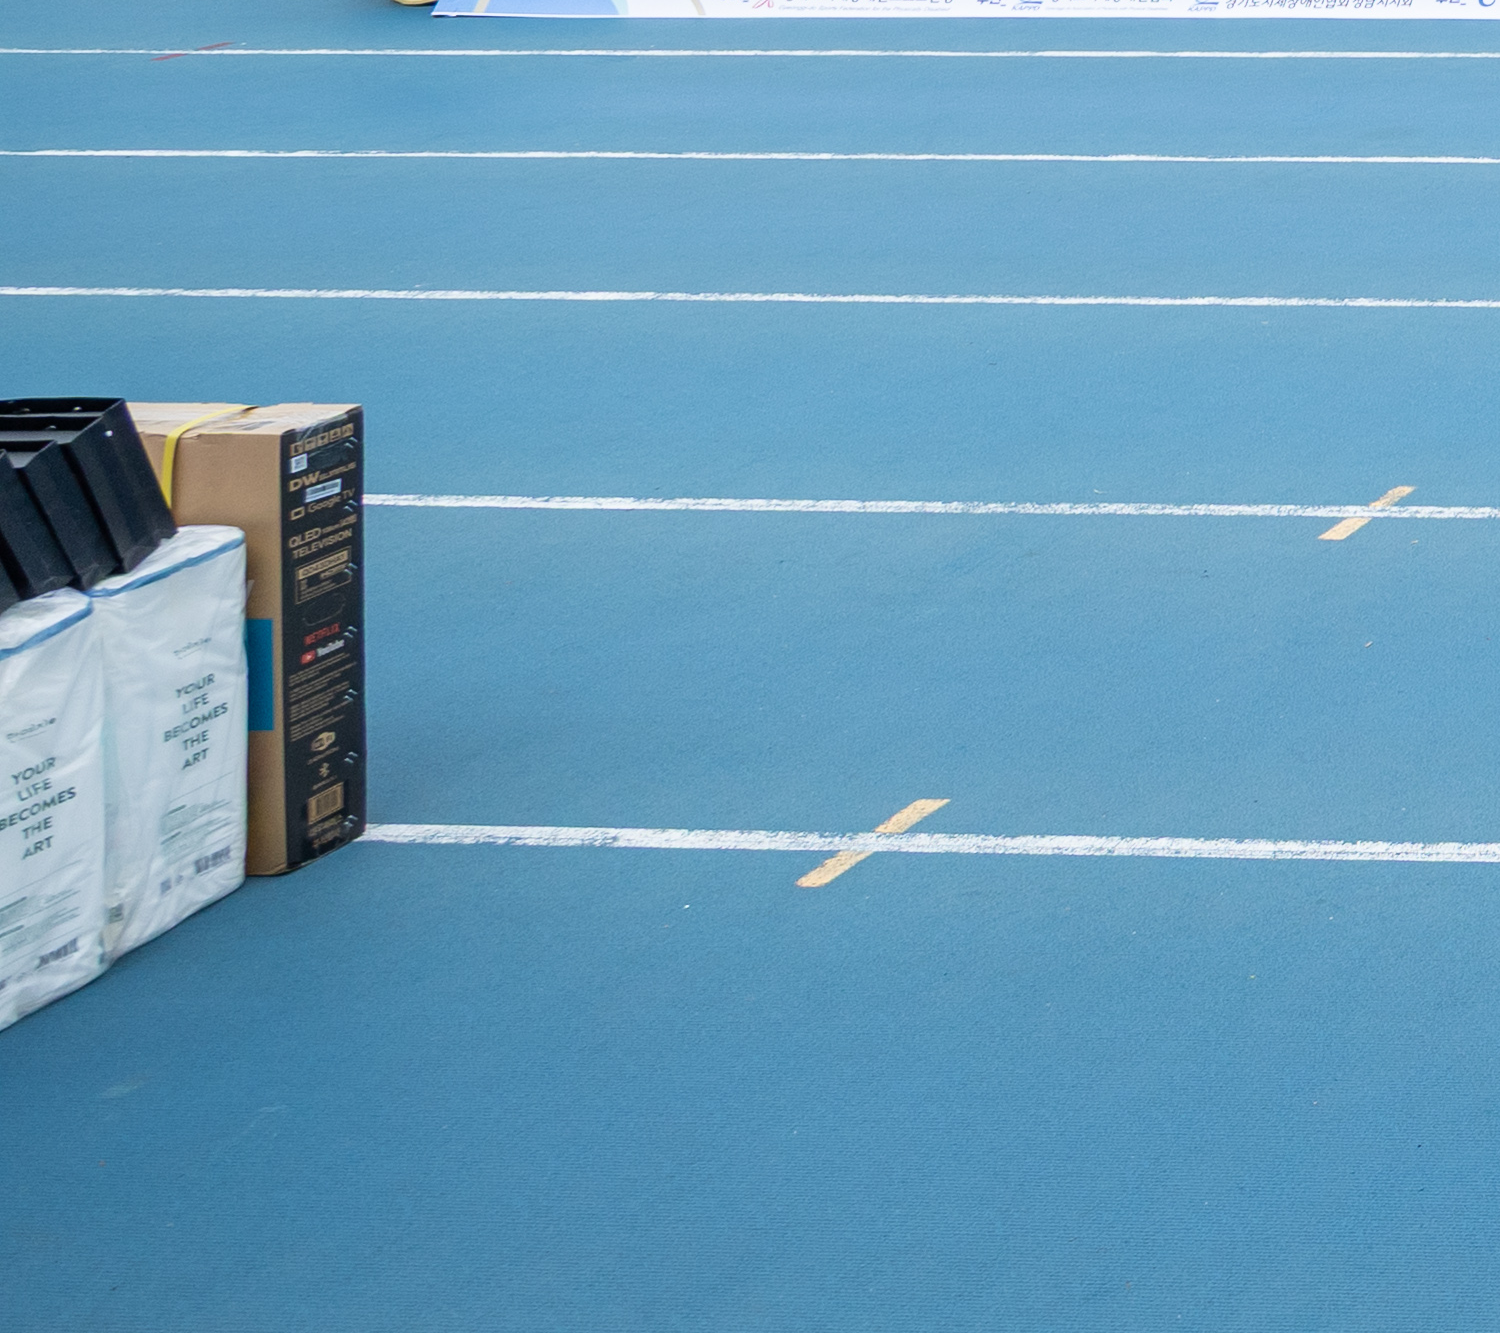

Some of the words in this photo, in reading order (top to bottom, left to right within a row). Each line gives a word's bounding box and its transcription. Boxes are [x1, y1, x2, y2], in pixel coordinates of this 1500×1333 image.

[289, 470, 320, 492] DW
[308, 495, 341, 513] Google
[342, 488, 355, 500] TV
[289, 527, 321, 549] QLED
[293, 528, 353, 559] TELEVISION
[176, 673, 216, 698] YOUR
[182, 693, 209, 714] LIFE
[163, 702, 229, 743] BECOMES
[182, 730, 210, 751] THE
[11, 757, 57, 784] YOUR
[181, 748, 210, 770] ART
[17, 780, 53, 802] LIFE
[22, 816, 54, 840] THE
[22, 835, 54, 860] ART
